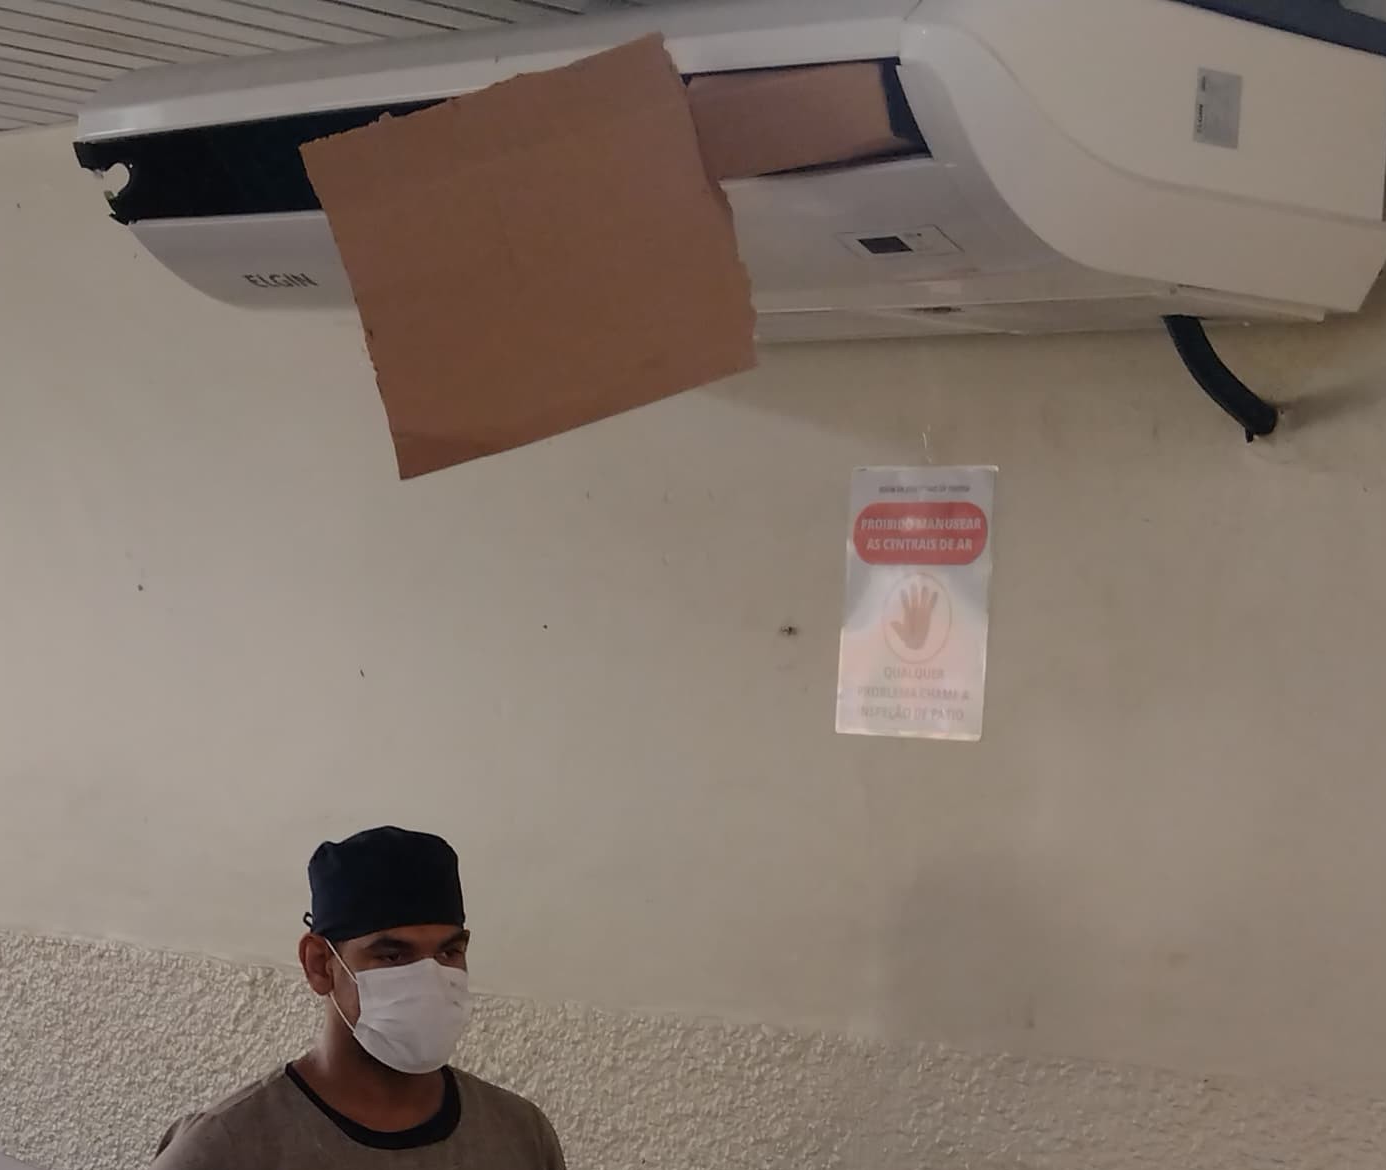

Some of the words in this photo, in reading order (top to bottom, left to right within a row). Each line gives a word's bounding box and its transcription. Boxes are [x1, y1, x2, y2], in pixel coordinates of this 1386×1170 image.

[243, 273, 318, 288] ELGIN
[861, 517, 913, 531] PROIBIDO
[913, 517, 981, 530] MANUSEAR
[866, 538, 881, 550] AS
[883, 538, 938, 551] CENTRAIS
[940, 539, 954, 551] DE
[955, 539, 973, 551] AR
[884, 666, 945, 680] QUALQUER
